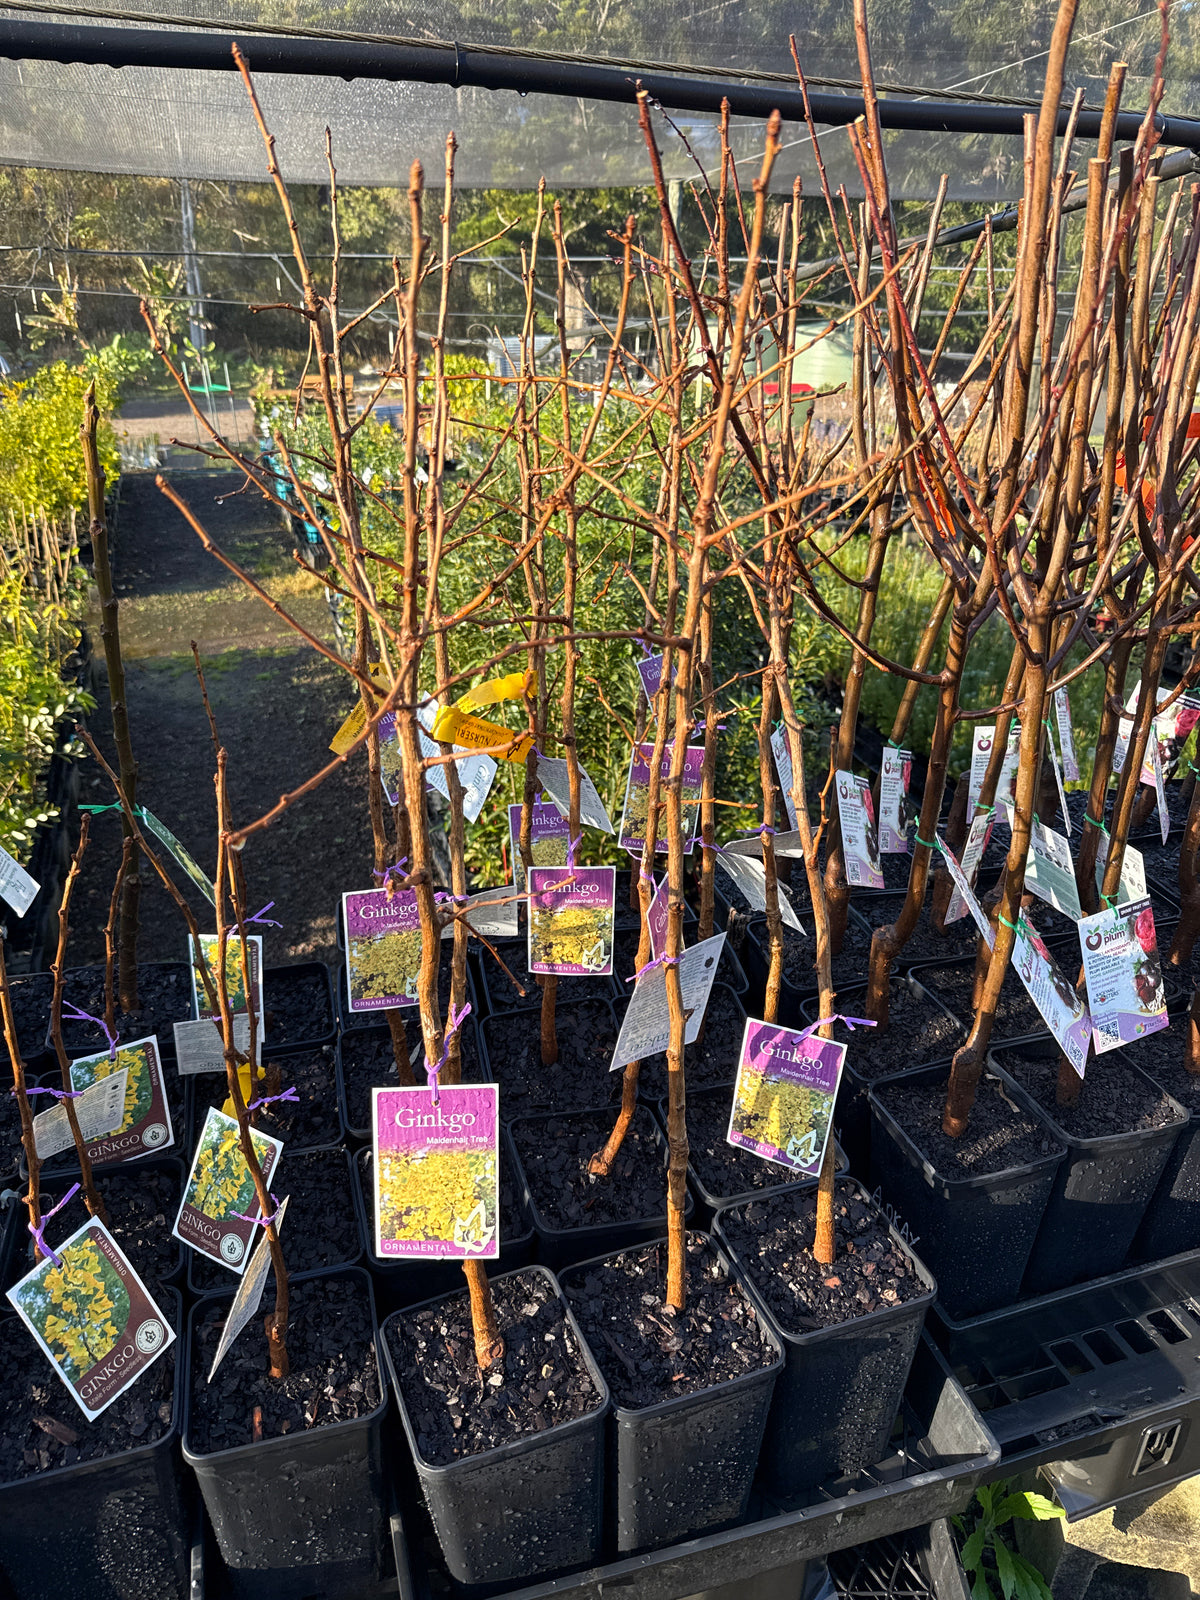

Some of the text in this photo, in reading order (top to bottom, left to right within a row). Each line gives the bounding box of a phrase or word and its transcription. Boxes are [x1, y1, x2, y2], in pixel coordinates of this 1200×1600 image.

[531, 814, 564, 828] inkgo
[543, 880, 599, 897] Ginkgo
[360, 902, 418, 920] Ginkgo
[1103, 922, 1128, 936] a-okay
[1104, 930, 1126, 945] plum
[354, 998, 404, 1008] ORNAMENTAL
[148, 1047, 159, 1086] ORNAMENTAL
[760, 1040, 823, 1072] Ginkgo
[781, 1067, 830, 1087] Maidenhair Tree
[395, 1108, 476, 1133] Ginkgo
[88, 1134, 140, 1159] GINKGO
[427, 1135, 489, 1145] Maidenhair Tree
[732, 1133, 784, 1160] ORNAMENTAL
[181, 1210, 221, 1241] GINKGO
[95, 1231, 127, 1277] ORNAMENTAL
[384, 1242, 452, 1252] ORNAMENTAL
[79, 1345, 135, 1400] GINKGO
[88, 1391, 102, 1406] Male
[102, 1379, 115, 1394] Form
[119, 1356, 142, 1377] Seedless
